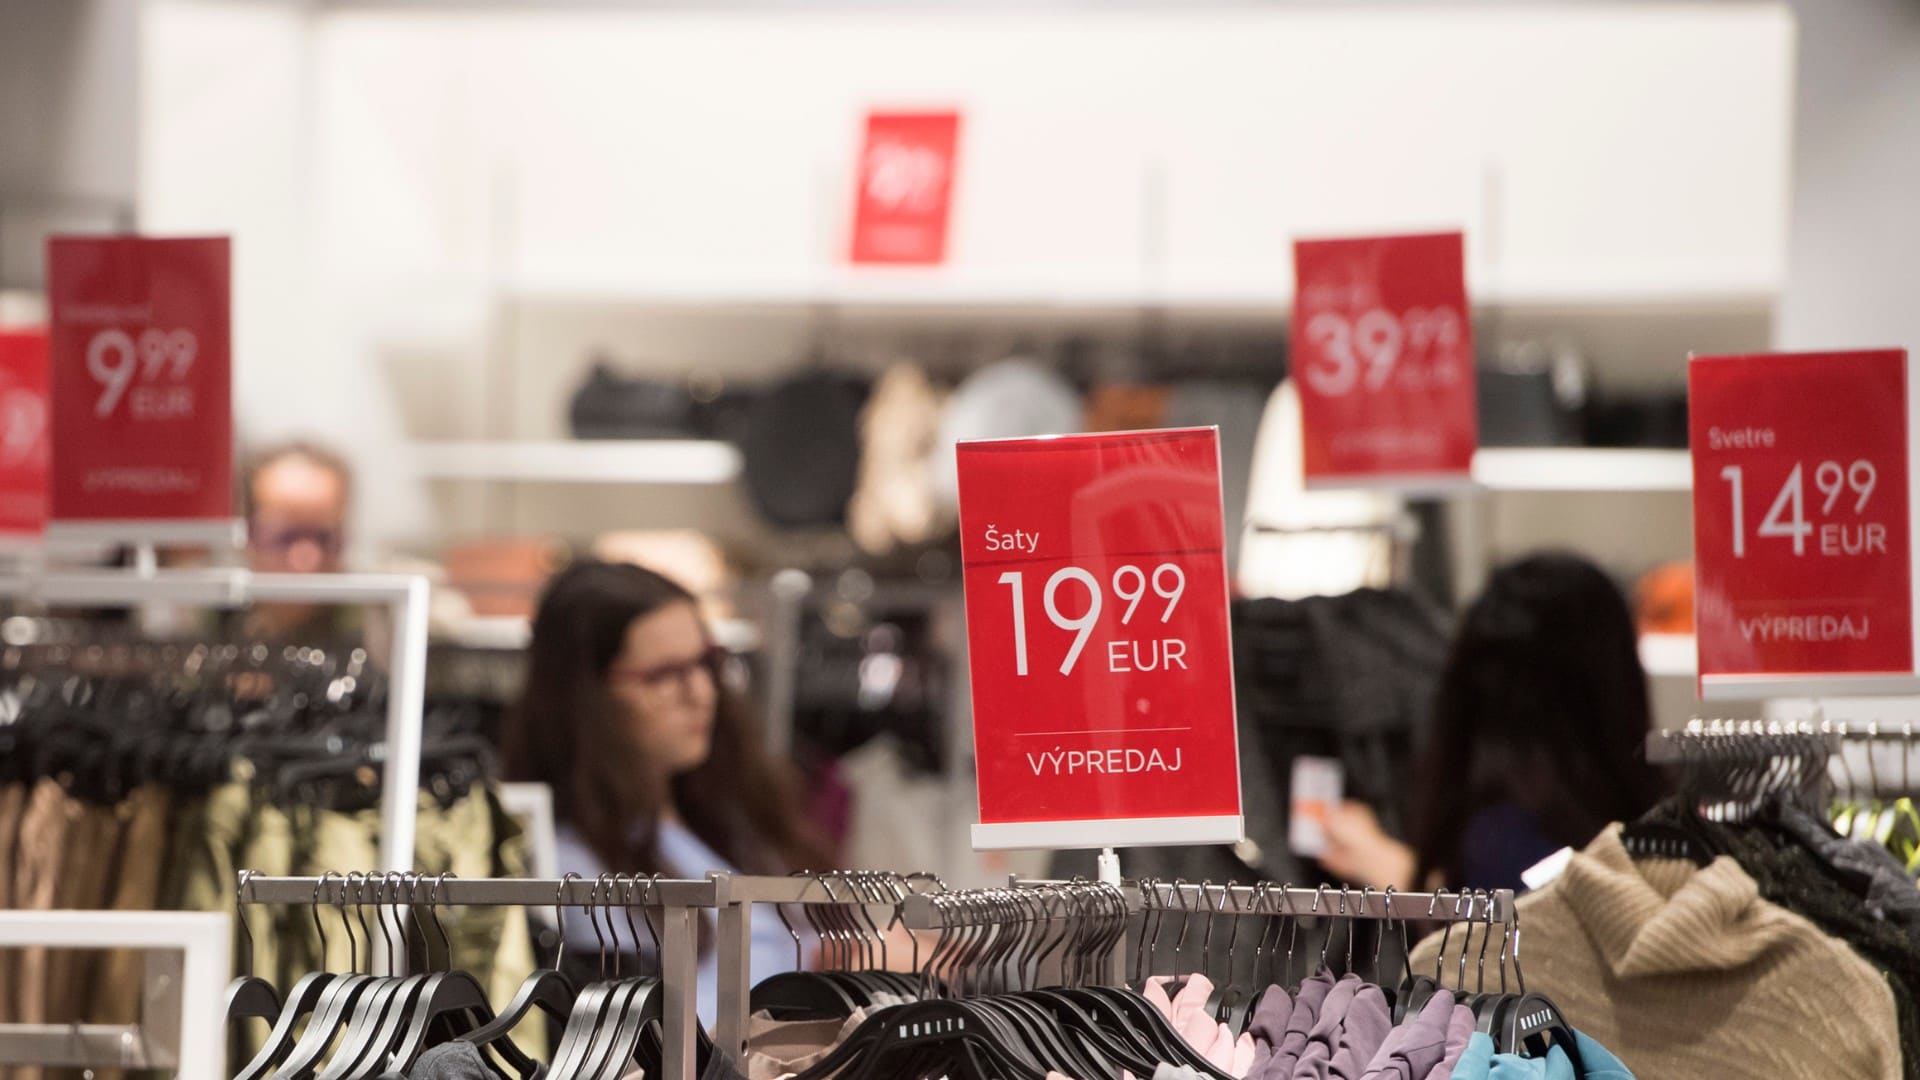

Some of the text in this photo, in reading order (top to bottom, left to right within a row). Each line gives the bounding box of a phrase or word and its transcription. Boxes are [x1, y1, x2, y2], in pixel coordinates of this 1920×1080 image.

[1708, 426, 1776, 449] Svetre
[984, 524, 1039, 553] Šaty
[1820, 523, 1886, 556] EUR
[998, 566, 1102, 677] 19
[1739, 612, 1869, 642] VÝPREDAJ
[1108, 639, 1187, 673] EUR
[1026, 746, 1182, 776] VÝPREDAJ
